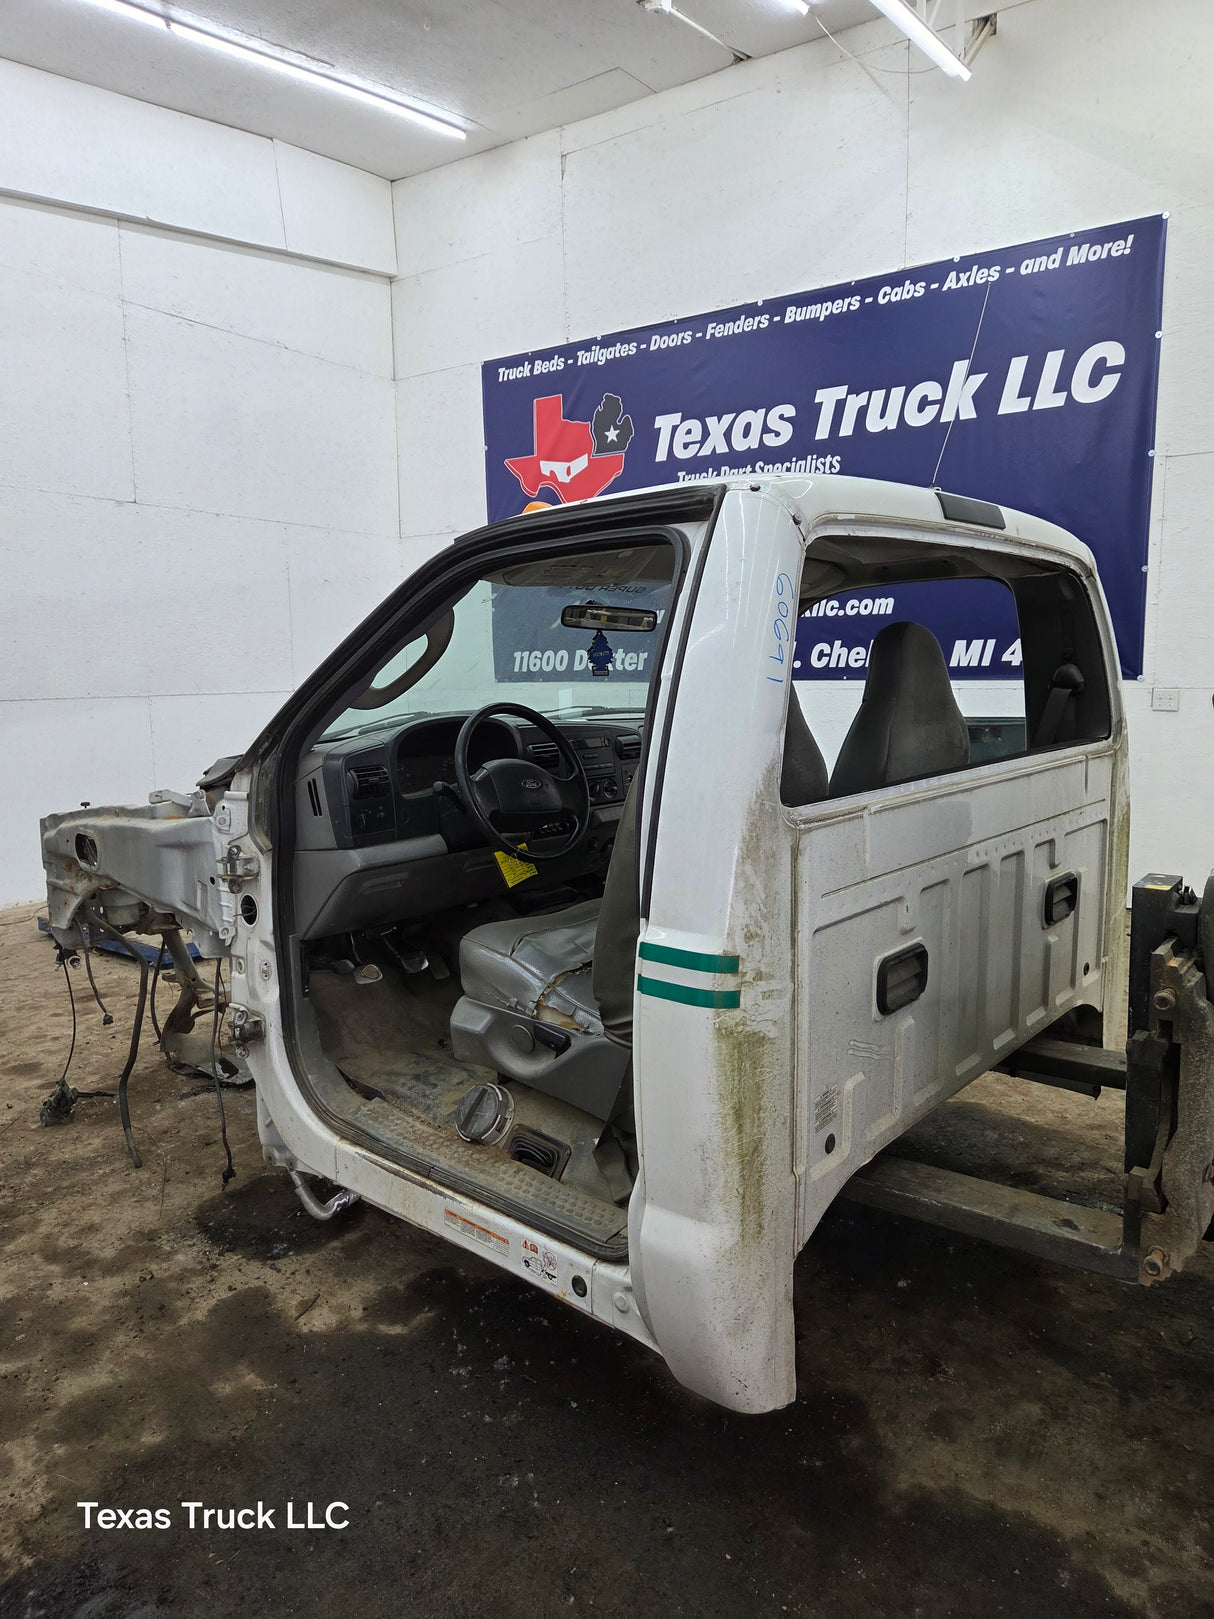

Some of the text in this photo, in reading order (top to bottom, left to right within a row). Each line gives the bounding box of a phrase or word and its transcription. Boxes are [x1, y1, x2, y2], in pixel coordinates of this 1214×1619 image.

[498, 361, 531, 382] Truck
[533, 355, 565, 375] Beds
[577, 341, 638, 366] Tailgates
[650, 329, 692, 351] Doors
[706, 313, 769, 340] Fenders
[784, 296, 861, 324] Bumpers
[877, 280, 926, 305] Cabs
[942, 265, 1001, 292] Axles
[1020, 249, 1063, 276] and
[1066, 234, 1135, 267] More!
[653, 341, 1126, 462] Texas Truck LLC
[513, 649, 569, 673] 11600
[573, 648, 649, 671] Dter
[949, 638, 996, 667] MI
